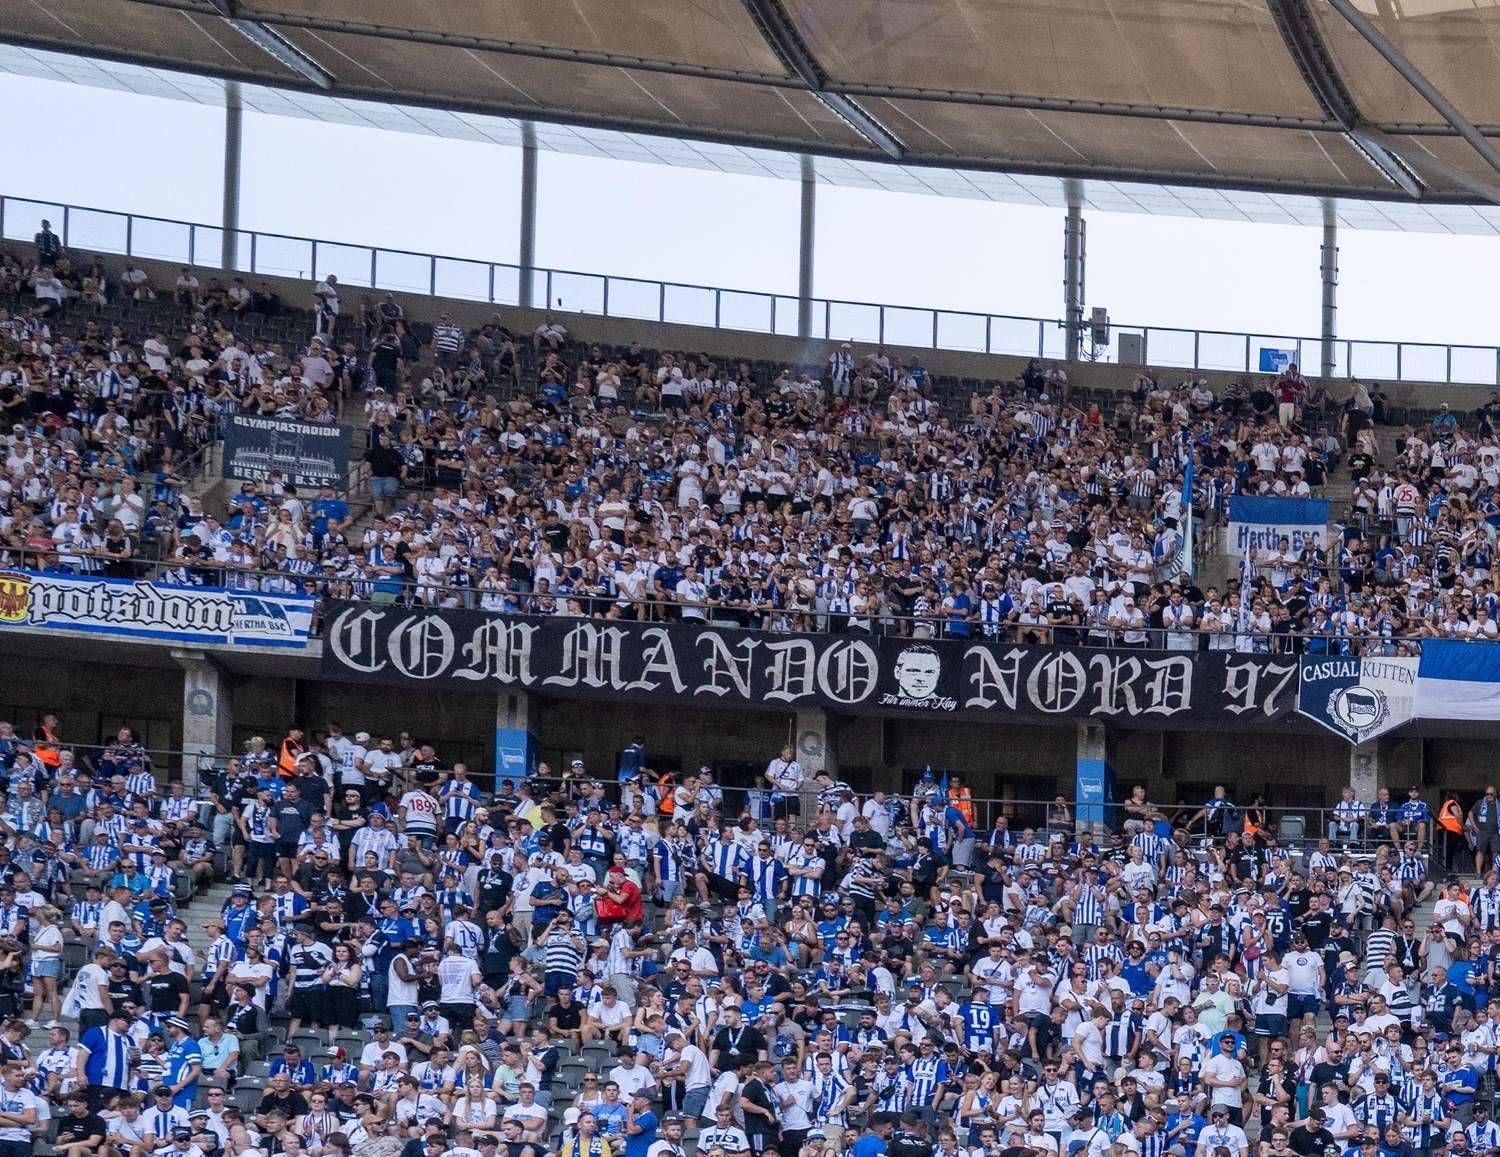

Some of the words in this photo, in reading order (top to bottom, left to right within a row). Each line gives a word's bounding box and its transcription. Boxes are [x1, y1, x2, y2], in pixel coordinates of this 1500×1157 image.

[234, 415, 341, 437] OLYMPIASTADION
[233, 466, 290, 483] HERTA
[1237, 526, 1288, 551] Herth
[269, 620, 287, 632] BSC
[963, 645, 1195, 717] NORD
[1302, 661, 1360, 682] CASUAL
[1362, 661, 1417, 685] KUTTEN
